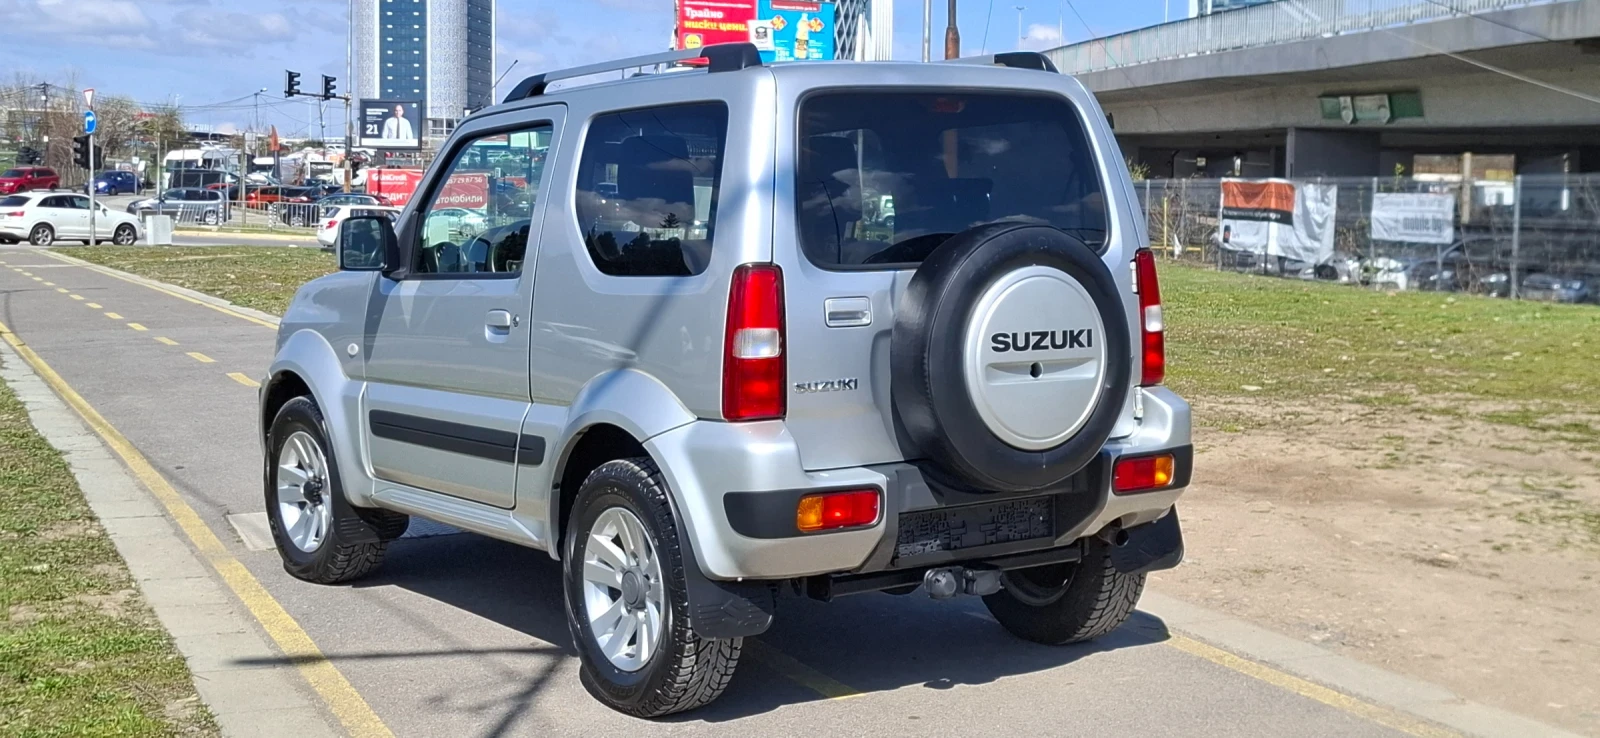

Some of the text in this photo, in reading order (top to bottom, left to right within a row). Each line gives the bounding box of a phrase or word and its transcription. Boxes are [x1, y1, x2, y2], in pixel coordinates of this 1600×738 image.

[685, 7, 723, 18] Трайно
[365, 123, 379, 135] 21
[371, 190, 409, 201] Кедит
[991, 328, 1093, 353] SUZUKI
[793, 378, 858, 394] SUZUKI
